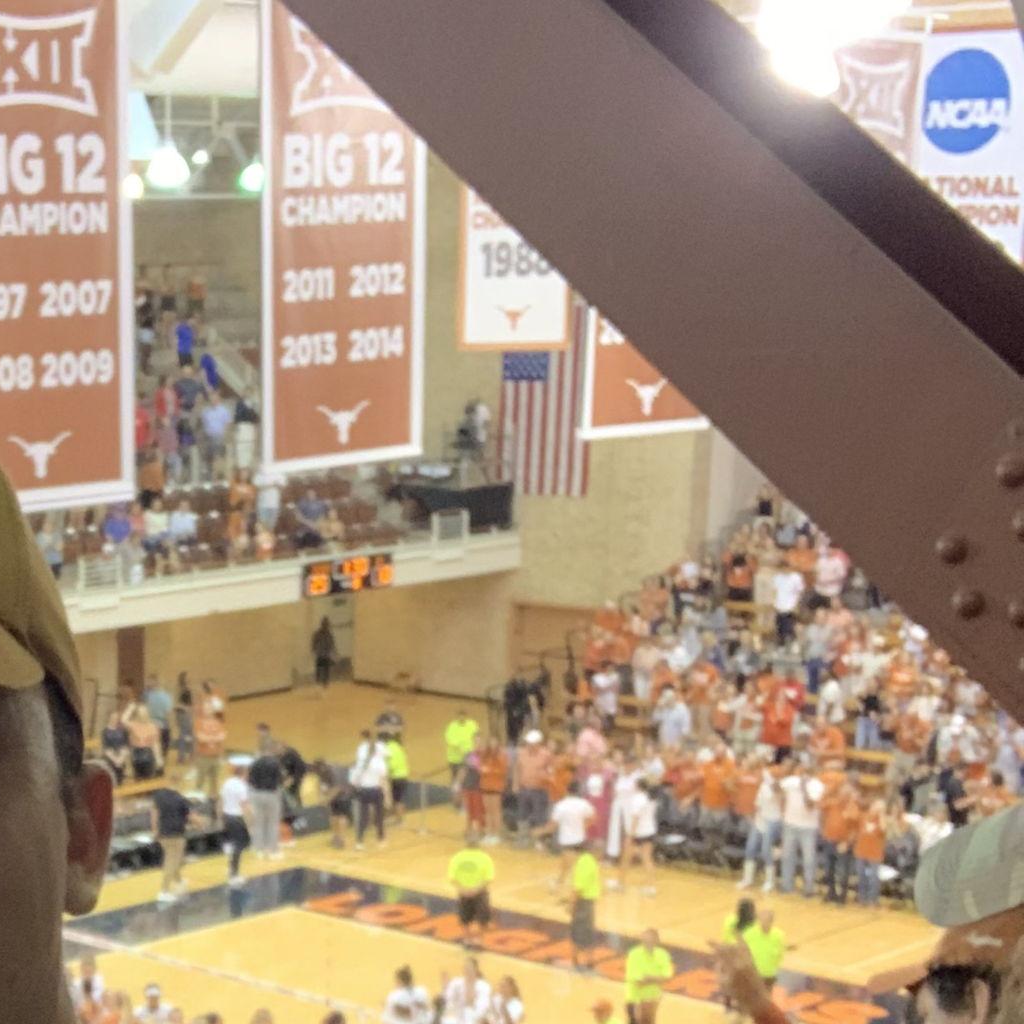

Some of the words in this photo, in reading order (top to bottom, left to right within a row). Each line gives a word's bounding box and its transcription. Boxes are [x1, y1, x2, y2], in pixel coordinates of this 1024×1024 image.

[926, 97, 1009, 130] NCAA
[54, 132, 108, 194] 12
[282, 131, 354, 188] BIG
[363, 130, 406, 186] 12
[934, 174, 1020, 197] TIONAL
[281, 192, 407, 227] CHAMPION
[39, 279, 112, 317] 2007
[282, 266, 335, 303] 2011
[349, 262, 406, 298] 2012
[280, 331, 338, 369] 2013
[347, 325, 404, 362] 2014
[40, 348, 114, 388] 2009
